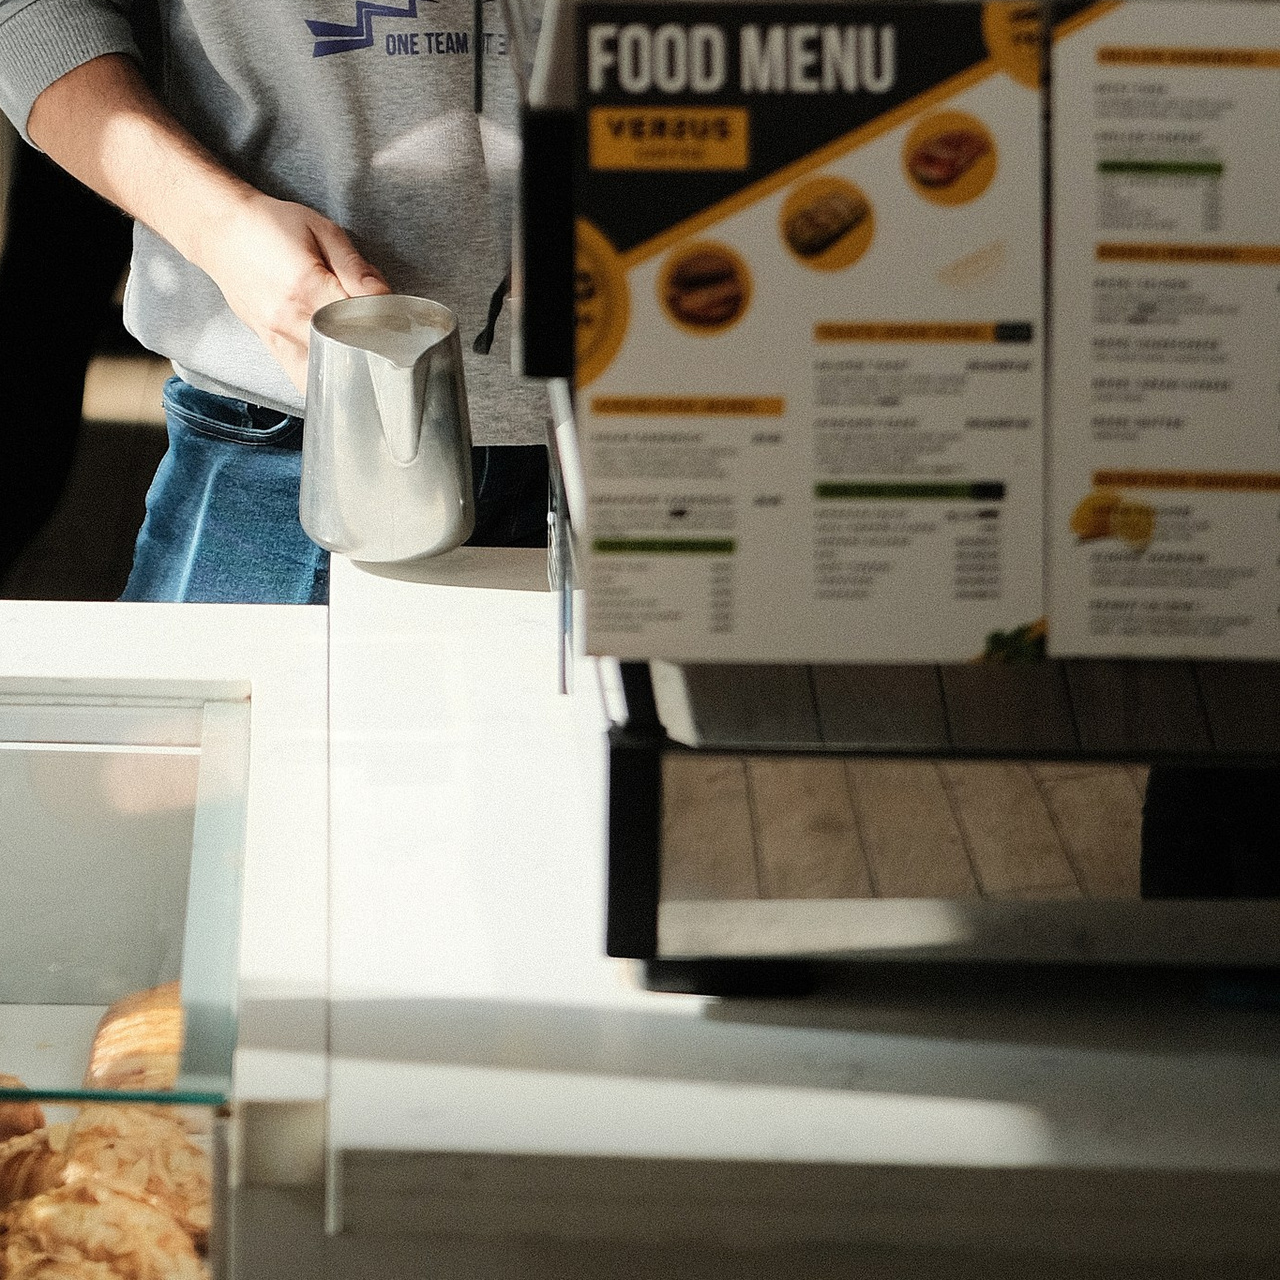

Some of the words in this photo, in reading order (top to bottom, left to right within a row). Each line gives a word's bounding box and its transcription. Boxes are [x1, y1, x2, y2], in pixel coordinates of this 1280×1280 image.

[385, 33, 420, 56] ONE
[424, 32, 469, 55] TEAM
[587, 24, 726, 94] FOOD
[739, 24, 898, 93] MENU
